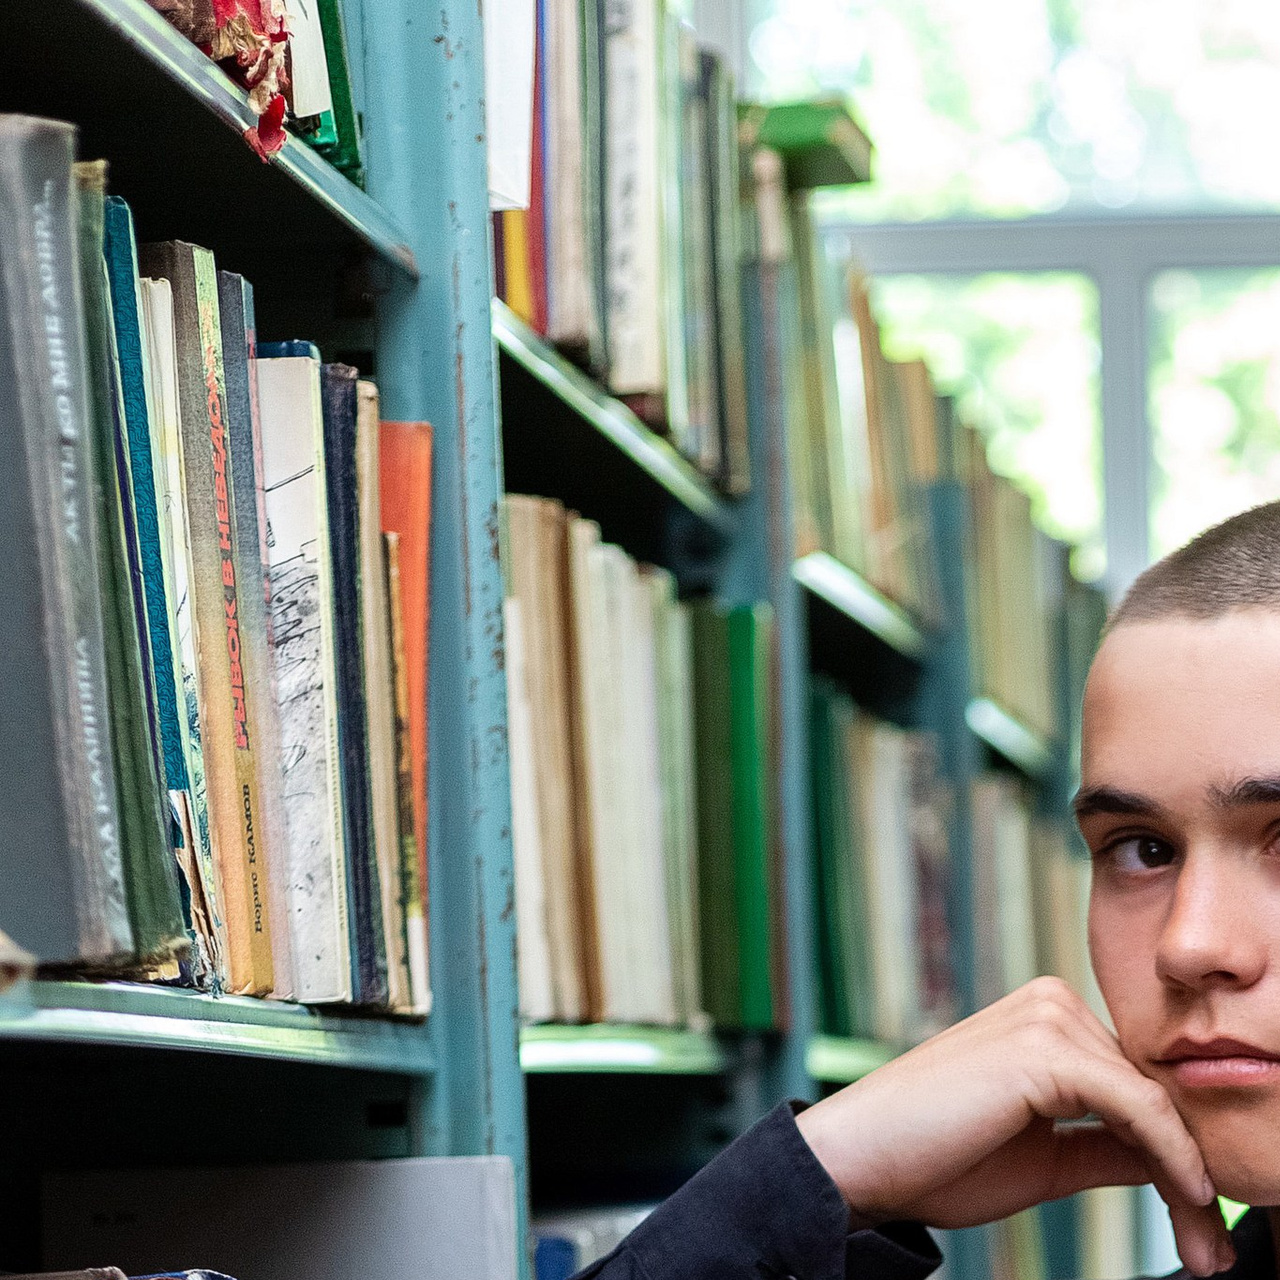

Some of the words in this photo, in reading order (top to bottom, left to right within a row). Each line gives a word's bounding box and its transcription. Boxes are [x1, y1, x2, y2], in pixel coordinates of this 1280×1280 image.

[222, 559, 236, 586] В
[224, 598, 250, 751] РЫВОК
[241, 785, 257, 863] КАМОВ
[252, 872, 263, 932] Борис
